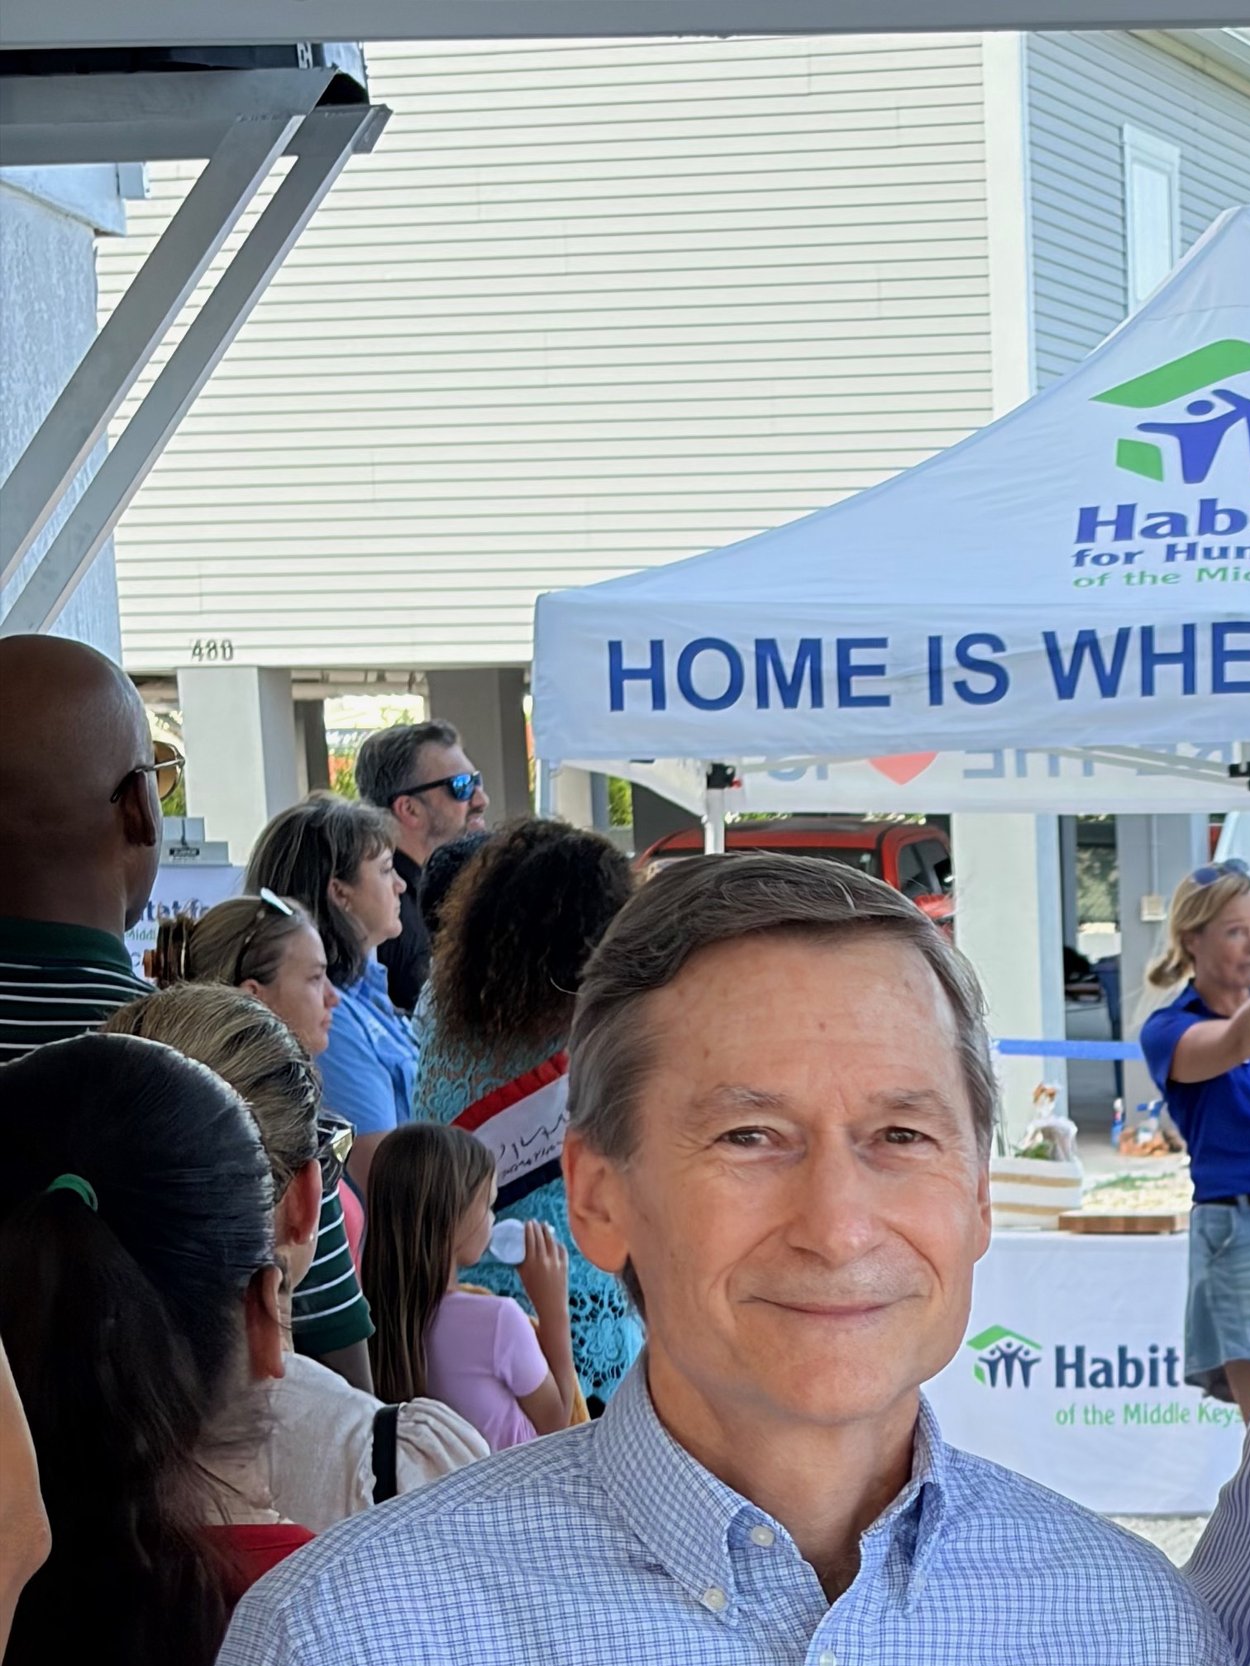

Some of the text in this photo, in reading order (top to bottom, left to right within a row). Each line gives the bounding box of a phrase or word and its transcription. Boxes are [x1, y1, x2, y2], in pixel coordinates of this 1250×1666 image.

[1070, 548, 1144, 568] for
[1073, 572, 1111, 588] of
[1122, 571, 1181, 585] the
[608, 636, 891, 713] HOME
[928, 632, 1010, 707] IS
[1055, 1344, 1181, 1388] Habit
[1056, 1404, 1077, 1426] of
[1084, 1404, 1115, 1425] the
[1123, 1404, 1190, 1425] Middle
